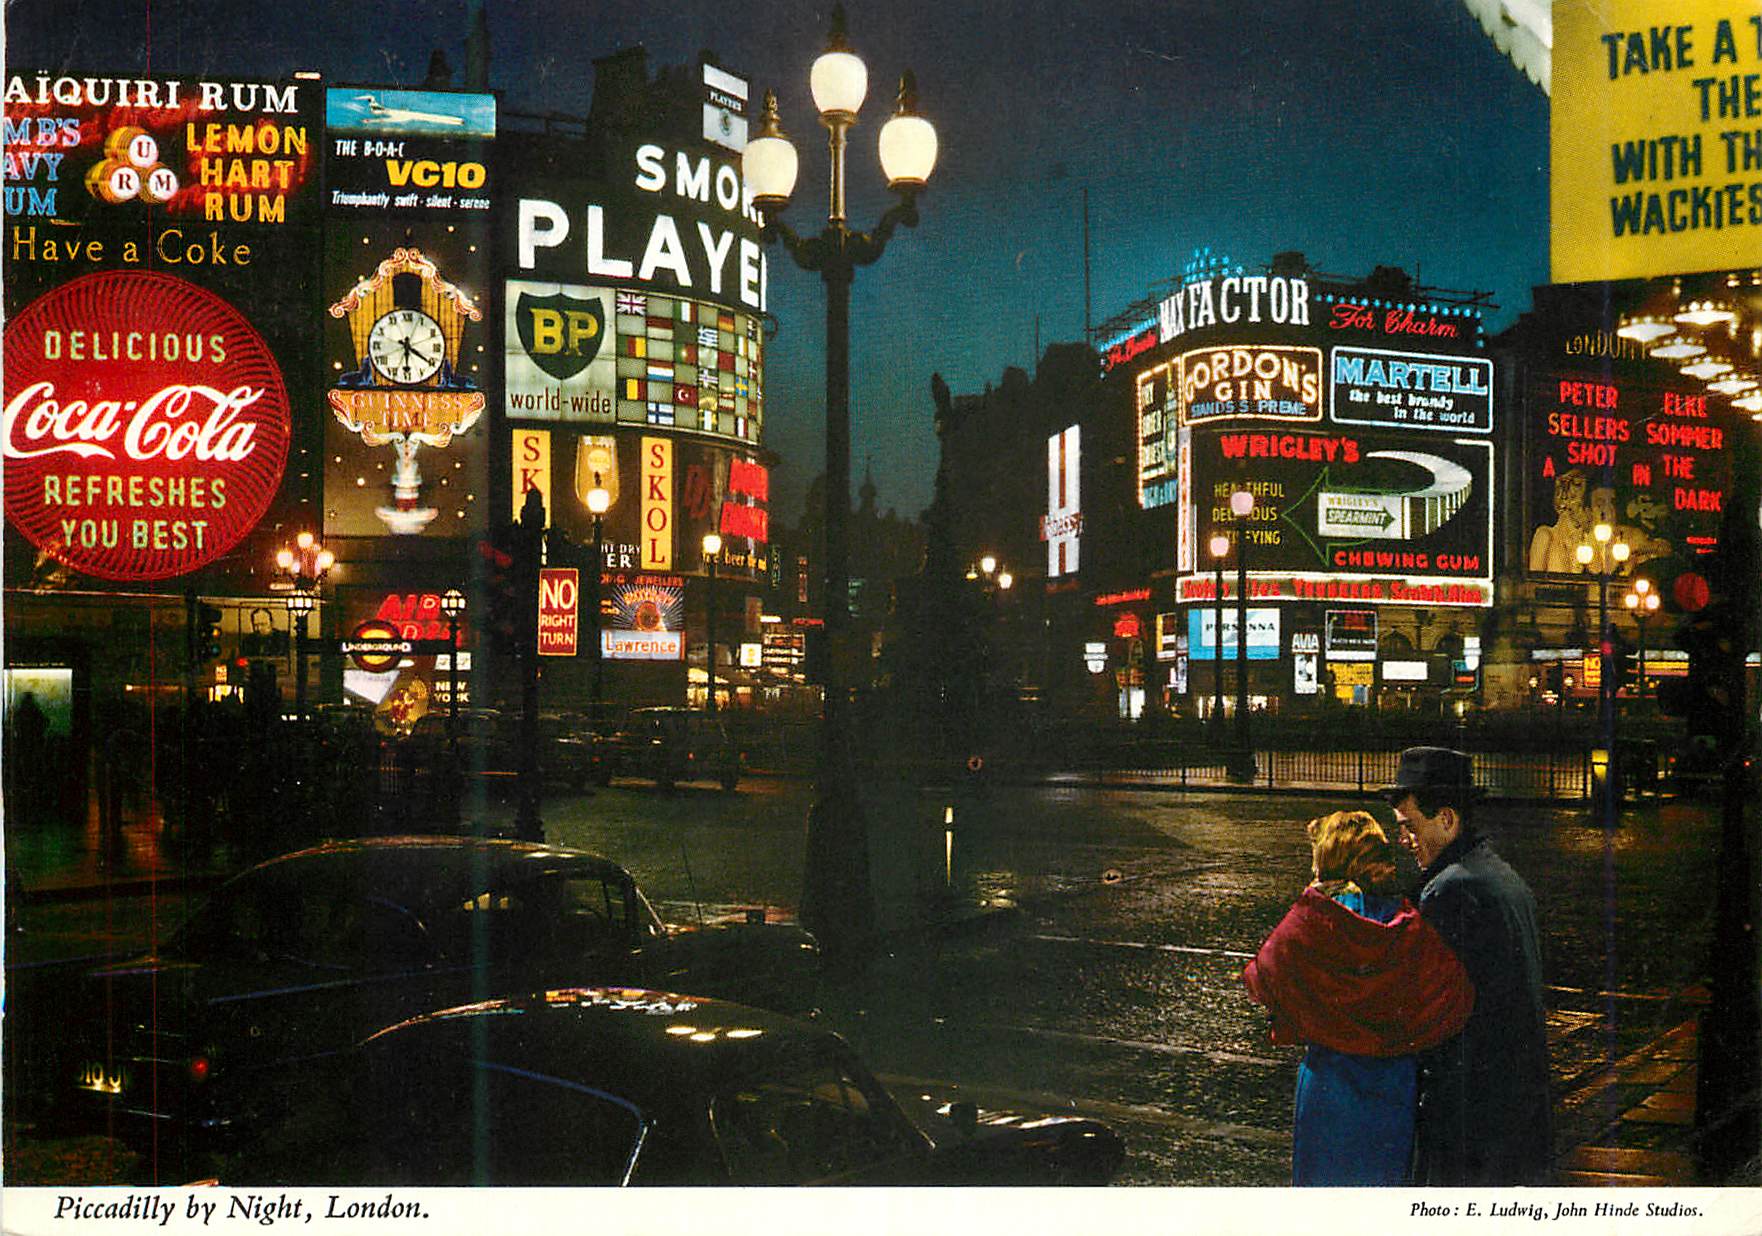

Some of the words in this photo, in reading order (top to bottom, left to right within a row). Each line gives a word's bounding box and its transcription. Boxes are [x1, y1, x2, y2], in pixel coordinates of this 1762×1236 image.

[1602, 25, 1694, 80] TAKE
[1713, 19, 1737, 64] A
[198, 82, 298, 113] RUM
[1692, 74, 1762, 122] THE
[186, 122, 307, 155] LEMON
[335, 139, 357, 156] THE
[200, 157, 295, 189] HART
[386, 159, 486, 189] VC10
[1611, 133, 1703, 184] WITH
[205, 191, 286, 223] RUM
[394, 193, 419, 207] swift
[459, 198, 490, 209] serene
[1610, 181, 1762, 237] WACKIES
[12, 226, 104, 262] Have
[122, 241, 140, 262] a
[157, 229, 251, 265] Coke
[1188, 276, 1310, 330] FACTOR
[531, 308, 599, 356] BP
[1329, 303, 1376, 330] For
[1384, 311, 1460, 338] Charm
[45, 331, 226, 363] DELICIOUS
[1186, 349, 1317, 404] GORDON'S
[1214, 380, 1273, 401] GIN
[1335, 356, 1489, 396] MARTELL
[510, 386, 612, 414] world-wide
[1349, 389, 1370, 403] the
[1377, 391, 1402, 405] best
[1408, 393, 1454, 410] brandy
[1560, 382, 1619, 409] PETER
[3, 381, 265, 461] Coca-Cola
[1394, 406, 1407, 419] in
[1414, 408, 1433, 420] the
[1440, 412, 1476, 424] world
[1548, 412, 1630, 442] SELLERS
[1220, 435, 1360, 463] WRIGLEY'S
[1647, 423, 1723, 450] SOMMER
[1543, 455, 1556, 478] A
[1568, 442, 1619, 466] SHOT
[1633, 463, 1650, 486] IN
[1664, 454, 1694, 479] THE
[44, 475, 226, 508] REFRESHES
[646, 444, 667, 564] SKOL
[1674, 487, 1722, 512] DARK
[1328, 509, 1388, 526] SPEARMINT
[61, 519, 118, 548] YOU
[132, 520, 208, 550] BEST
[1436, 555, 1480, 571] GUM
[541, 578, 575, 610] NO
[541, 615, 575, 627] RIGHT
[342, 642, 412, 652] UNDERGROUND
[541, 632, 574, 645] TURN
[604, 630, 677, 653] Lawrence
